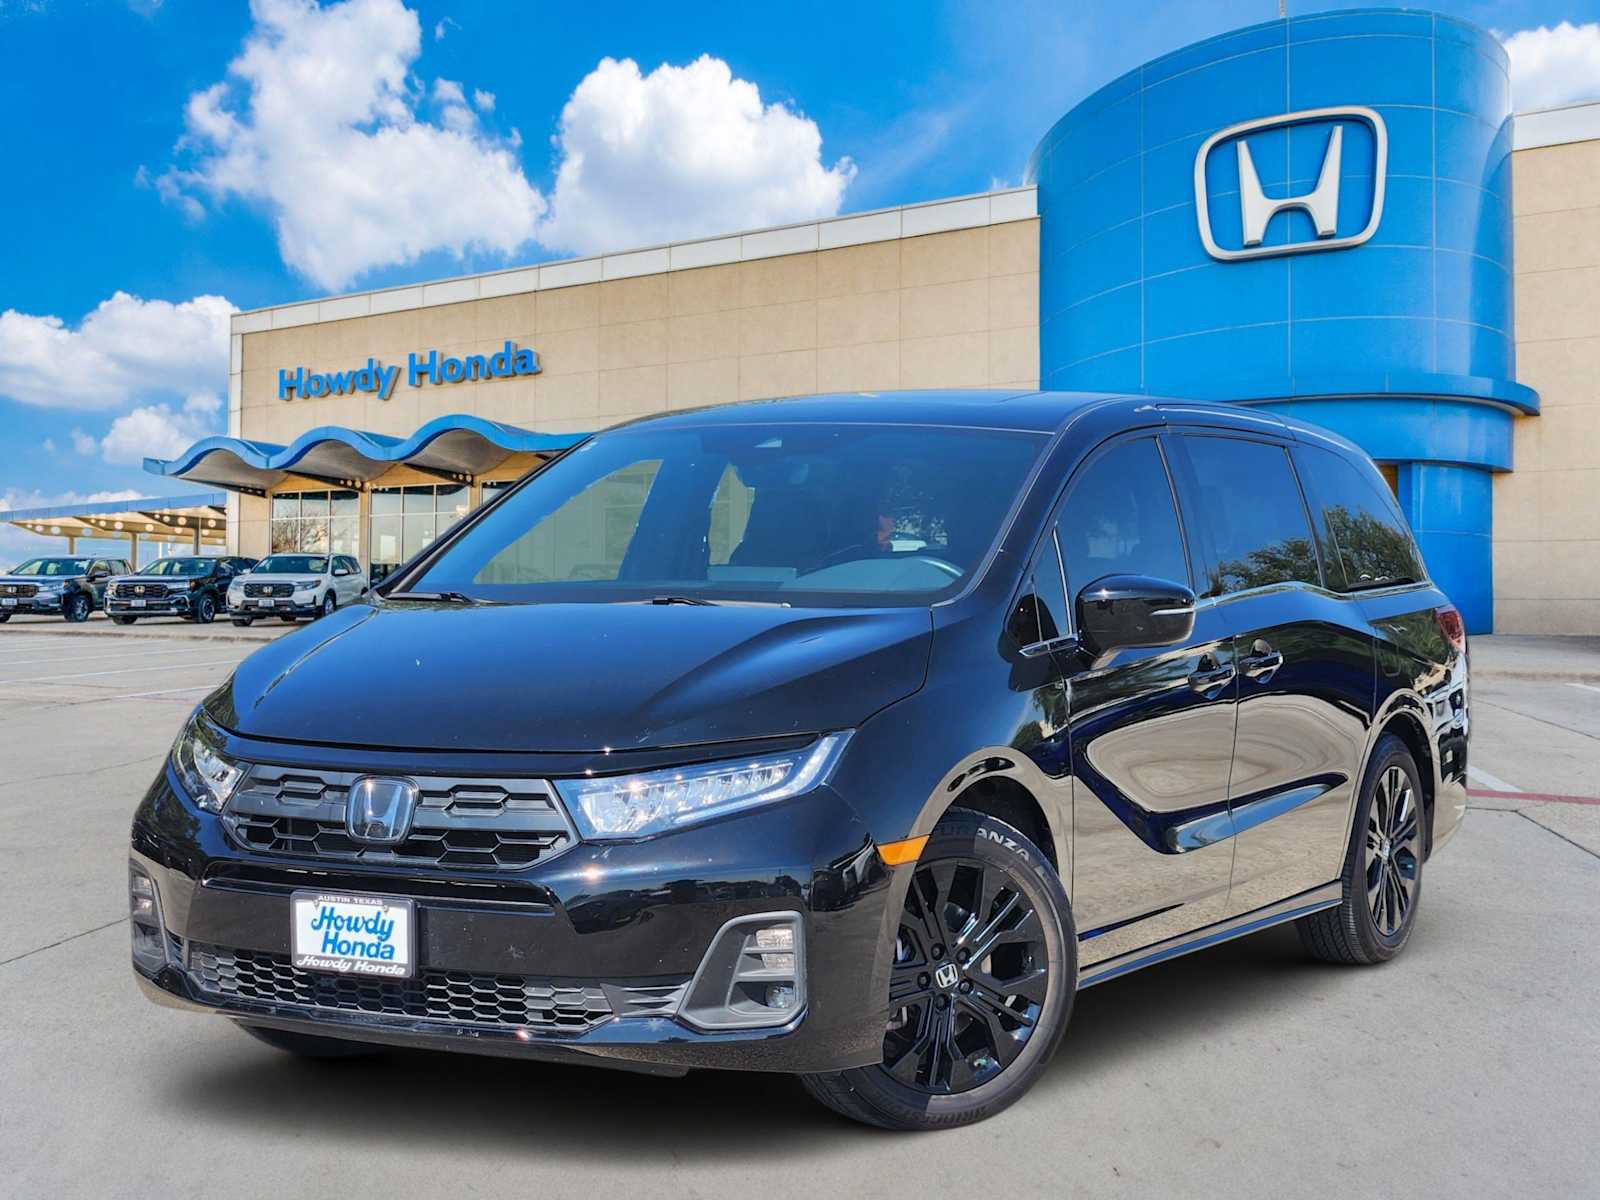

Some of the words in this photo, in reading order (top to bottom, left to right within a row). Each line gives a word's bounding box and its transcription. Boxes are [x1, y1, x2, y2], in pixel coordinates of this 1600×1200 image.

[278, 358, 400, 400] Howdy
[408, 341, 541, 387] Honda
[318, 895, 351, 903] AUSTIN
[353, 897, 384, 906] TEXAS
[310, 905, 395, 942] Howdy
[321, 930, 396, 960] Honda
[296, 955, 352, 972] Howdy
[354, 961, 406, 975] Honda
